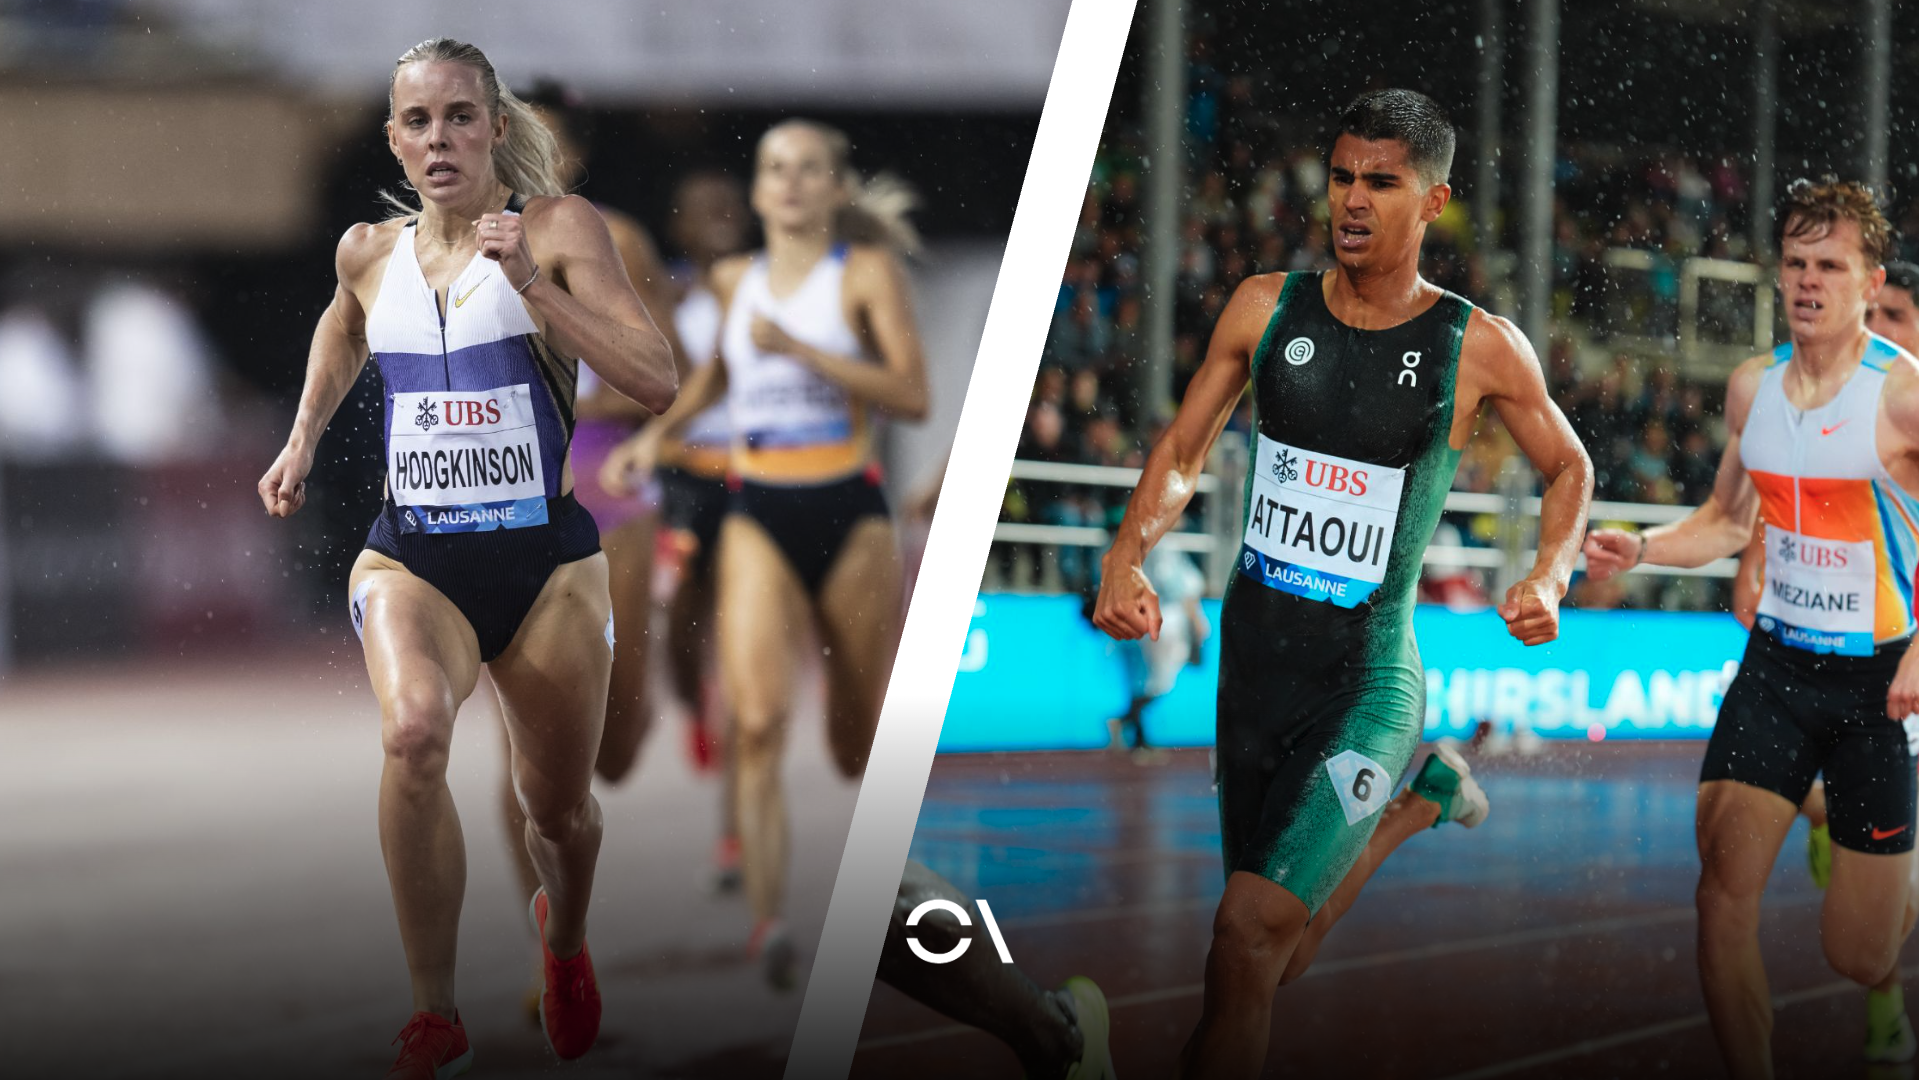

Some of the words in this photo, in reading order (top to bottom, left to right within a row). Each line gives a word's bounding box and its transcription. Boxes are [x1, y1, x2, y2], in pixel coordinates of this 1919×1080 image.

[443, 398, 501, 426] UBS
[395, 442, 535, 490] HODGKINSON
[1304, 458, 1369, 497] UBS
[426, 506, 516, 526] LAUSANNE
[1251, 493, 1385, 566] ATTAOUI
[1800, 543, 1849, 569] UBS
[1264, 562, 1348, 598] LAUSANNE
[1771, 578, 1860, 612] MEZIANE
[1782, 625, 1846, 648] LAUSANNE
[1352, 768, 1376, 802] 6
